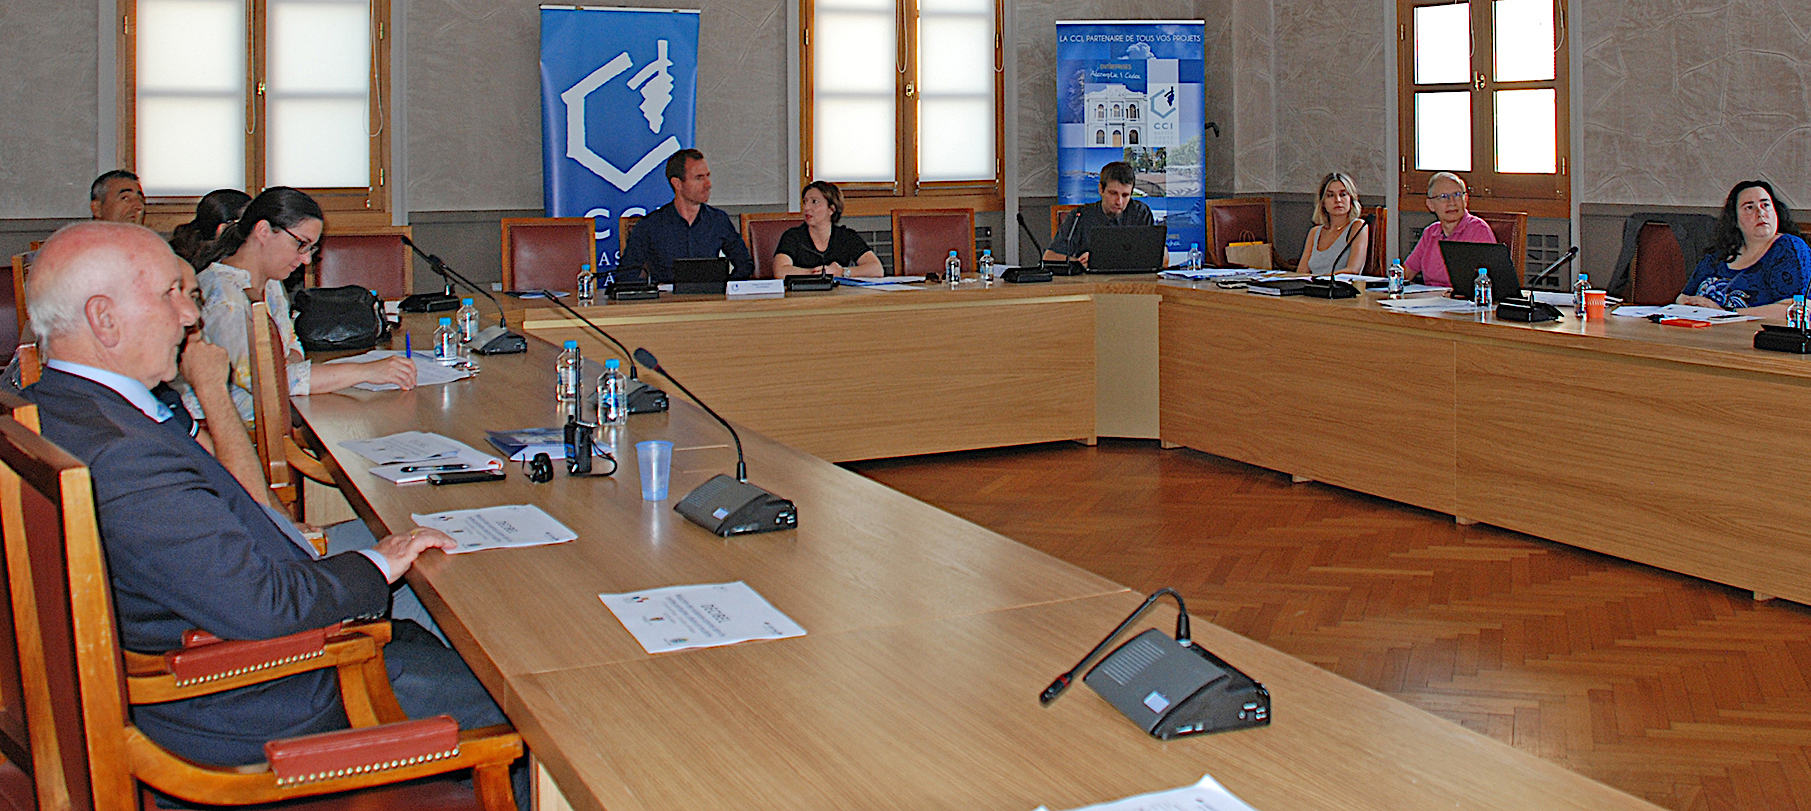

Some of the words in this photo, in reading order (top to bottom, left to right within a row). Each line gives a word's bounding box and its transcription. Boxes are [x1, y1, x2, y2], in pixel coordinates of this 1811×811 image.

[1059, 35, 1068, 43] LA
[1086, 35, 1123, 43] PARTENAIRE
[1153, 122, 1173, 130] CCI
